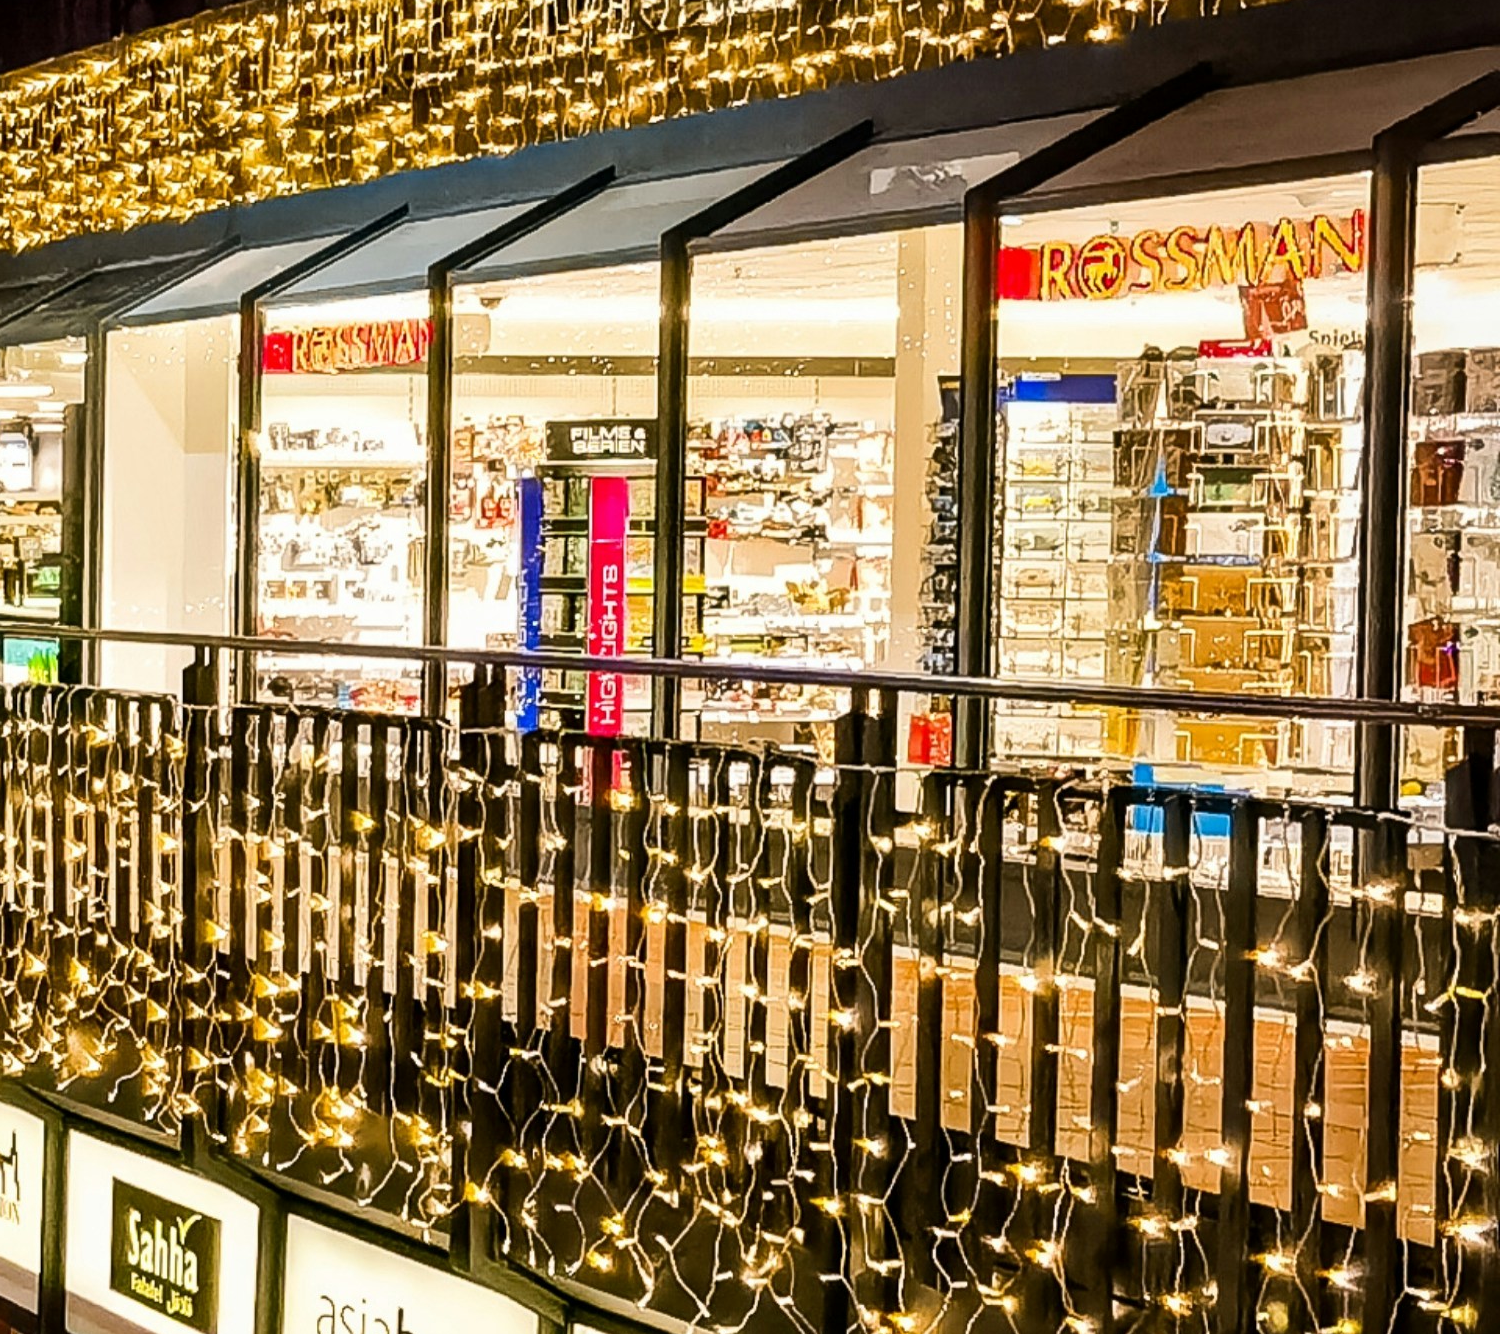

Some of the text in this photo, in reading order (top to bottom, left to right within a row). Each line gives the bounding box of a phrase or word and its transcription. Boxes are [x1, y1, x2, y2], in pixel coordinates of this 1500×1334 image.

[570, 426, 631, 441] FILME
[571, 439, 646, 455] SERIEN
[127, 1207, 201, 1293] Sahha
